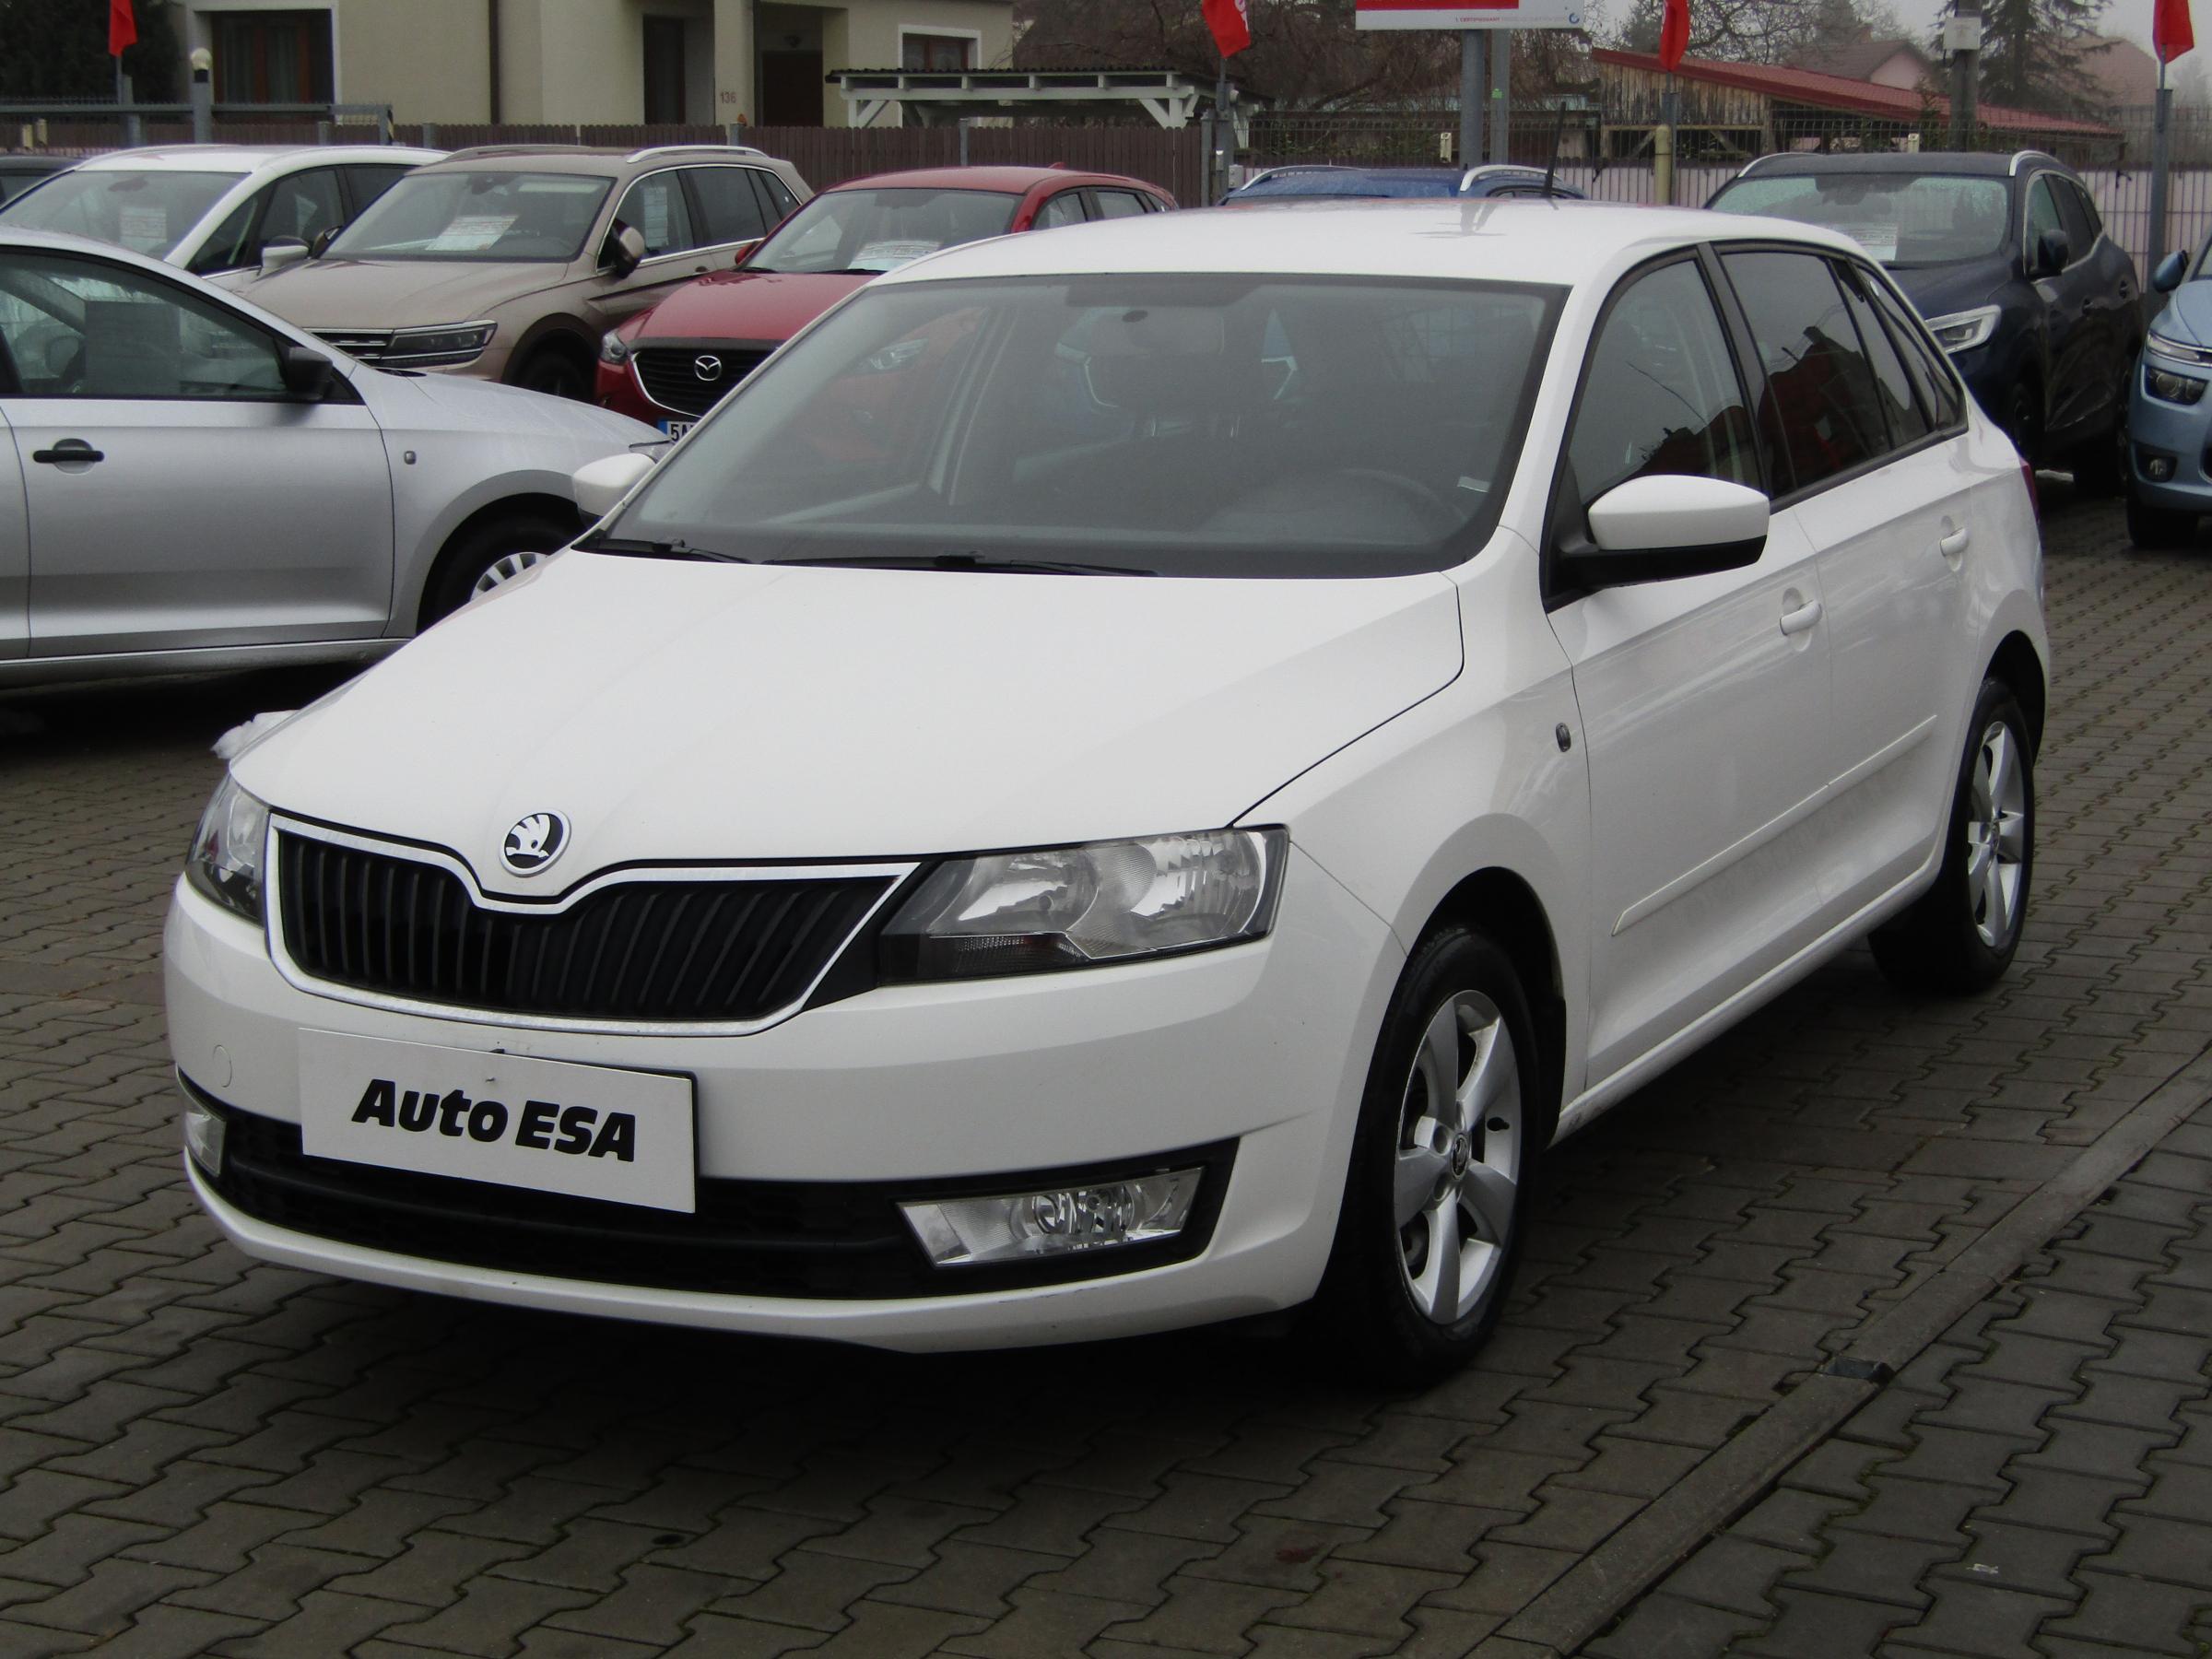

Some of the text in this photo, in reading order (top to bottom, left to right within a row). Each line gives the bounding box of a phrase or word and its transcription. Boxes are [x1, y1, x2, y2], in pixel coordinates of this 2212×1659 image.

[720, 91, 737, 104] 136
[670, 423, 694, 441] 5A
[351, 1079, 636, 1163] Auto ESA
